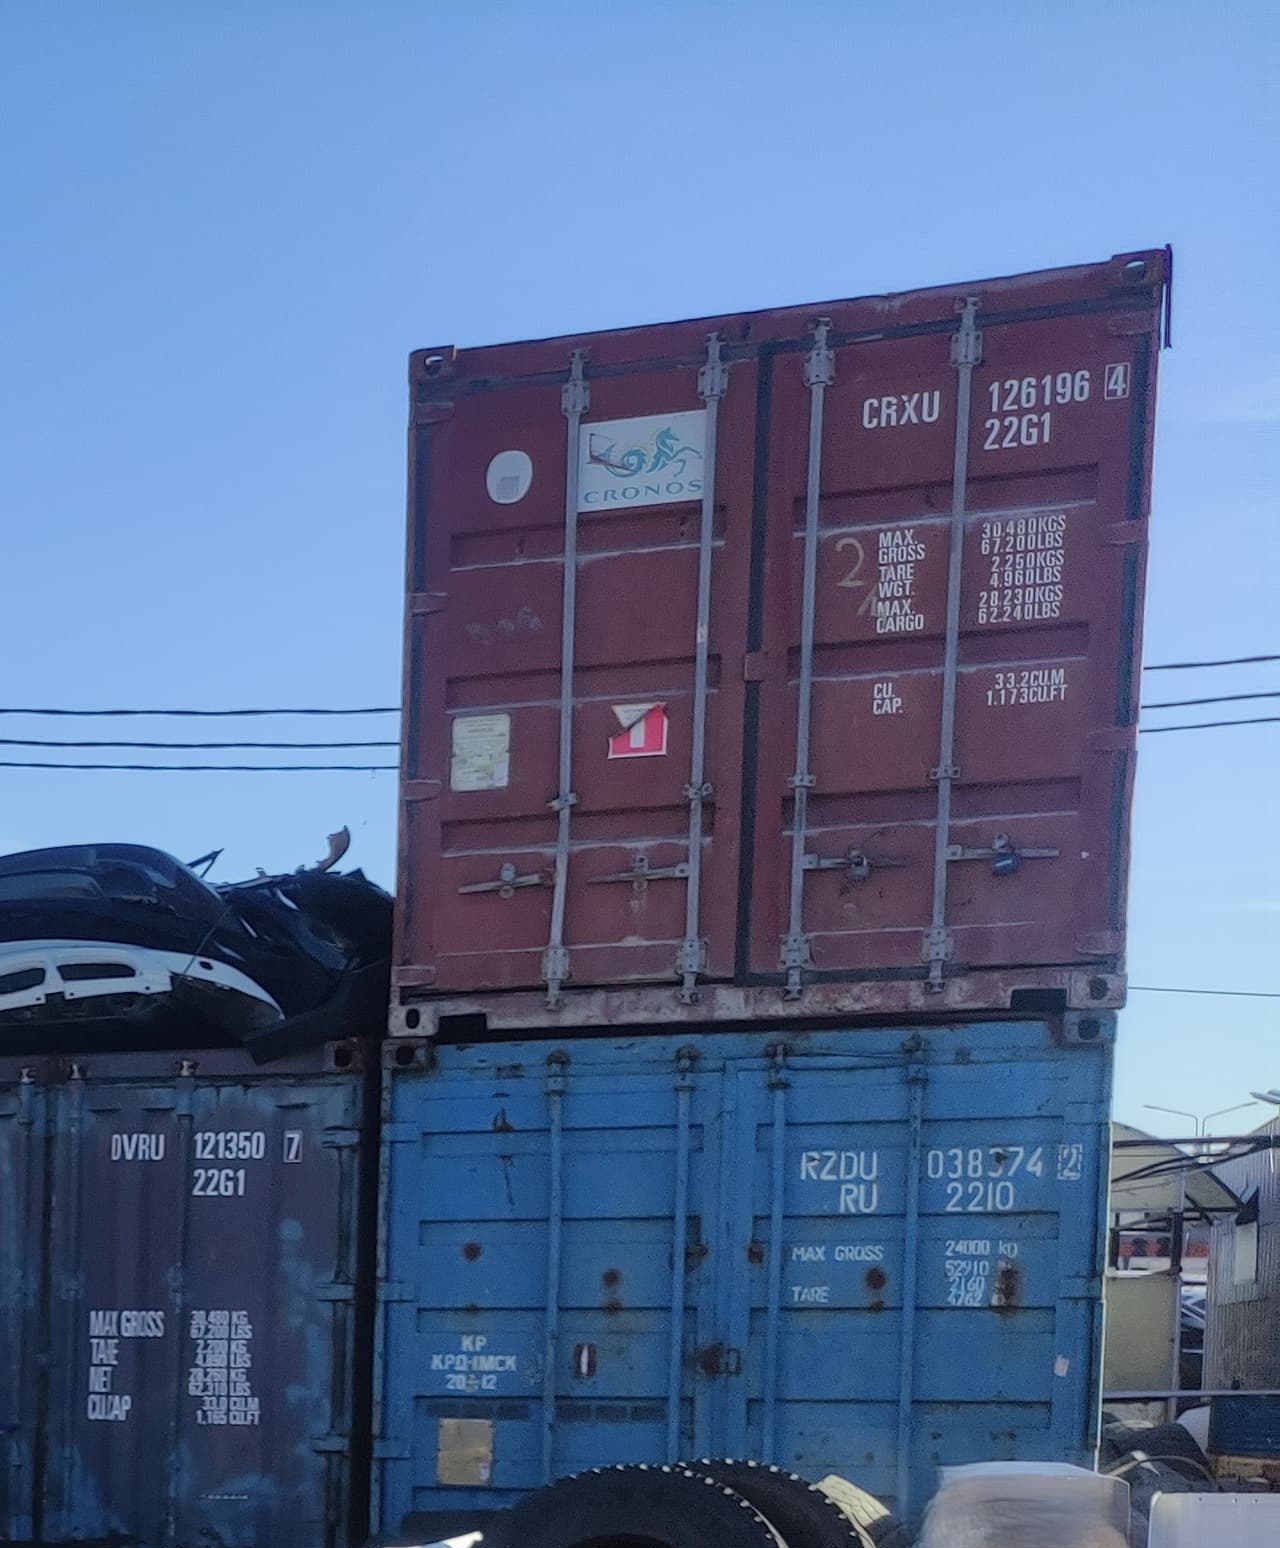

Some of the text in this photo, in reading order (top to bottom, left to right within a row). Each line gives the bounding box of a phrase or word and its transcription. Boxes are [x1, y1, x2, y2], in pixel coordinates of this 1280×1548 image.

[862, 365, 1128, 429] CRXU 126196 4
[984, 412, 1051, 450] 22G1
[583, 479, 702, 504] CRONOS
[879, 529, 918, 548] MAX.
[878, 544, 926, 564] GROSS
[879, 563, 915, 581] TARE
[879, 580, 915, 598] WGT.
[877, 599, 916, 616] MAX.
[876, 614, 924, 633] CARGO
[874, 683, 895, 698] CU.
[873, 698, 903, 714] CAP.
[111, 1131, 302, 1161] DVRU 121350 7
[800, 1151, 879, 1181] RZDU
[1060, 1147, 1082, 1179] 2
[192, 1169, 246, 1196] 22G1
[840, 1181, 1014, 1213] RU 2210
[792, 1247, 826, 1261] MAX
[835, 1246, 885, 1261] GROSS
[945, 1239, 990, 1256] 24000
[945, 1260, 989, 1276] 52910
[792, 1286, 832, 1302] TARE
[121, 1310, 165, 1337] GROSS
